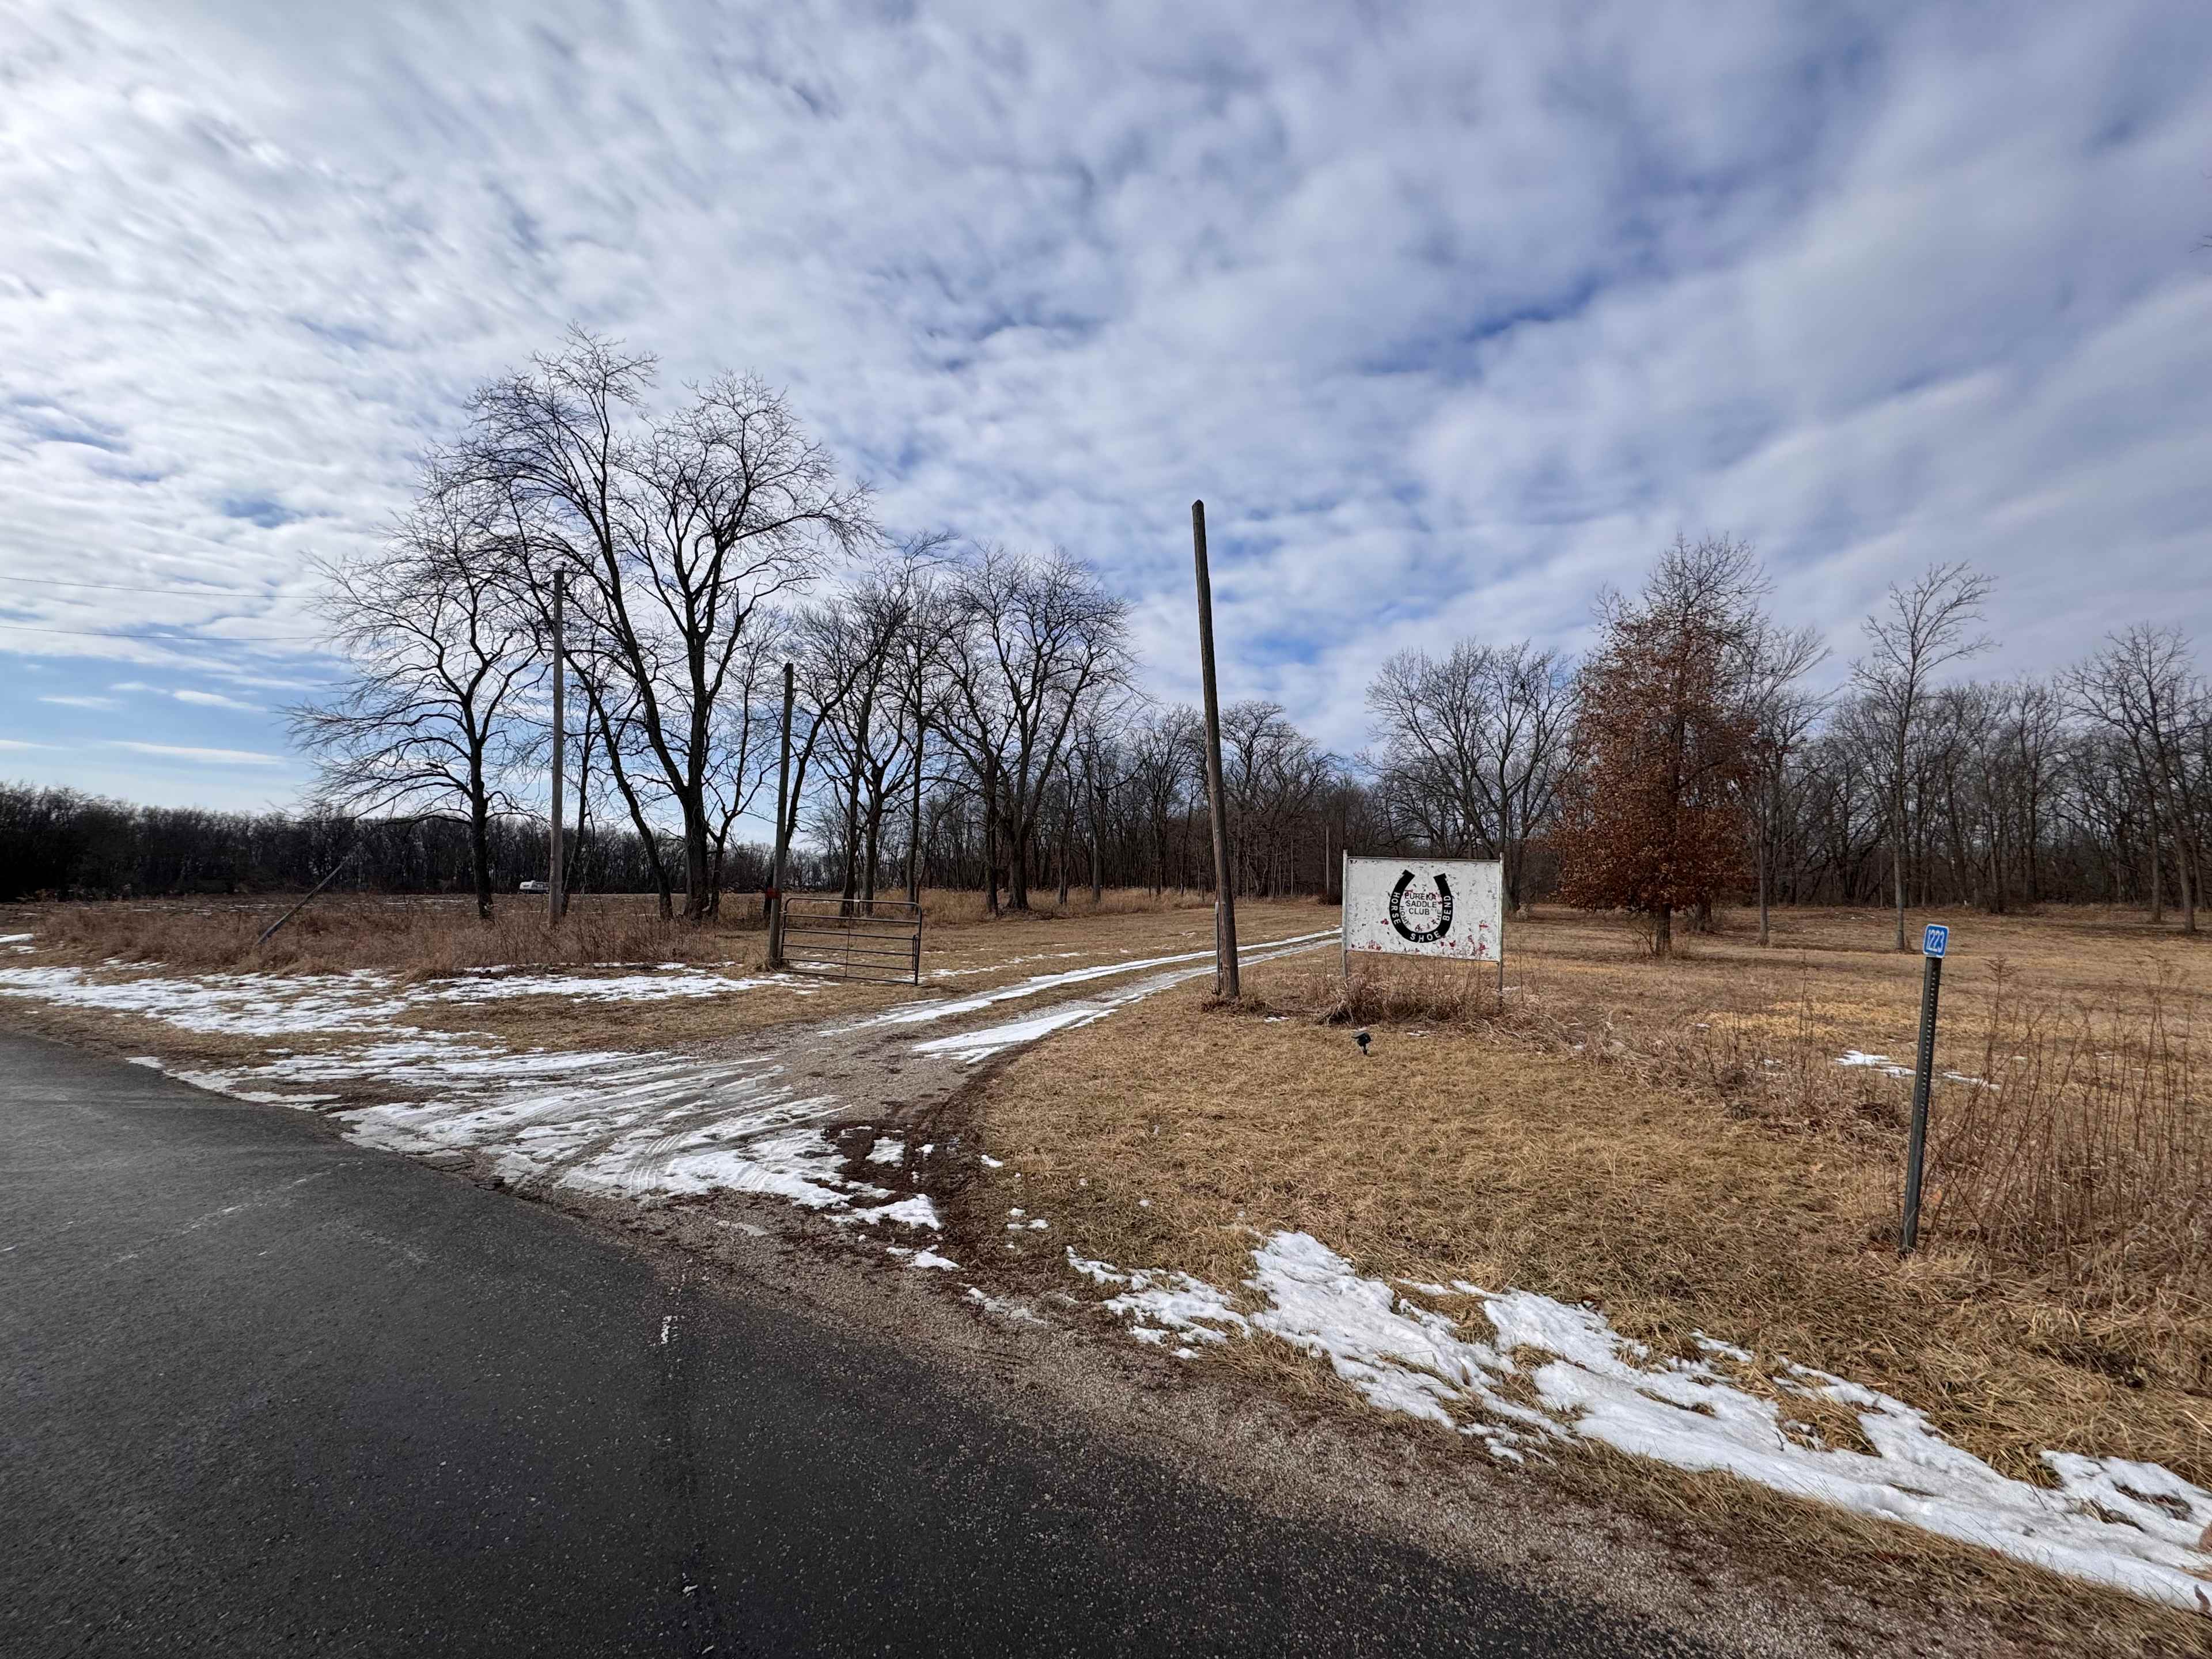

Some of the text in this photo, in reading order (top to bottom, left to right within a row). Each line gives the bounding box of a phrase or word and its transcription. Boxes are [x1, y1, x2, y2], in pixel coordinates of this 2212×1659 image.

[1404, 892, 1437, 900] EUREKA
[1391, 892, 1452, 942] HORSE SHOE BEND
[1926, 929, 1945, 953] 1223
